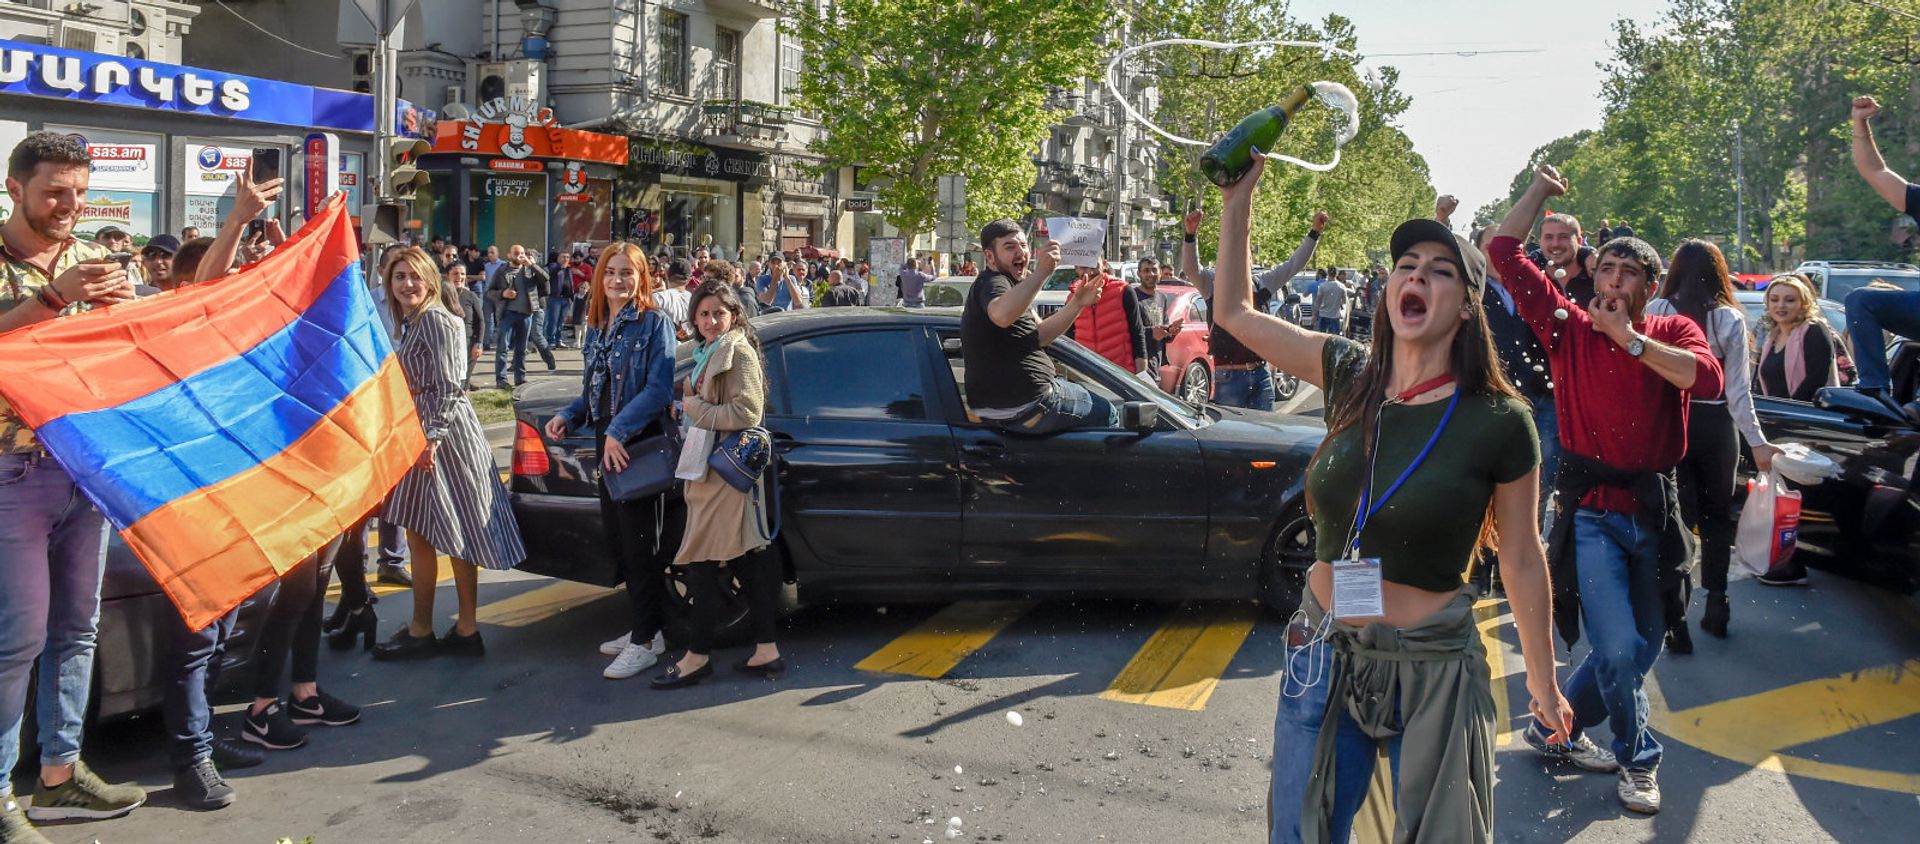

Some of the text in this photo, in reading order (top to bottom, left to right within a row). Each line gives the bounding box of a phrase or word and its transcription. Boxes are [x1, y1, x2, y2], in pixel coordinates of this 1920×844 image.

[462, 95, 539, 150] SHAURMA
[93, 147, 142, 158] sas.am
[494, 186, 530, 197] 87-77
[80, 206, 130, 219] ARIANNA
